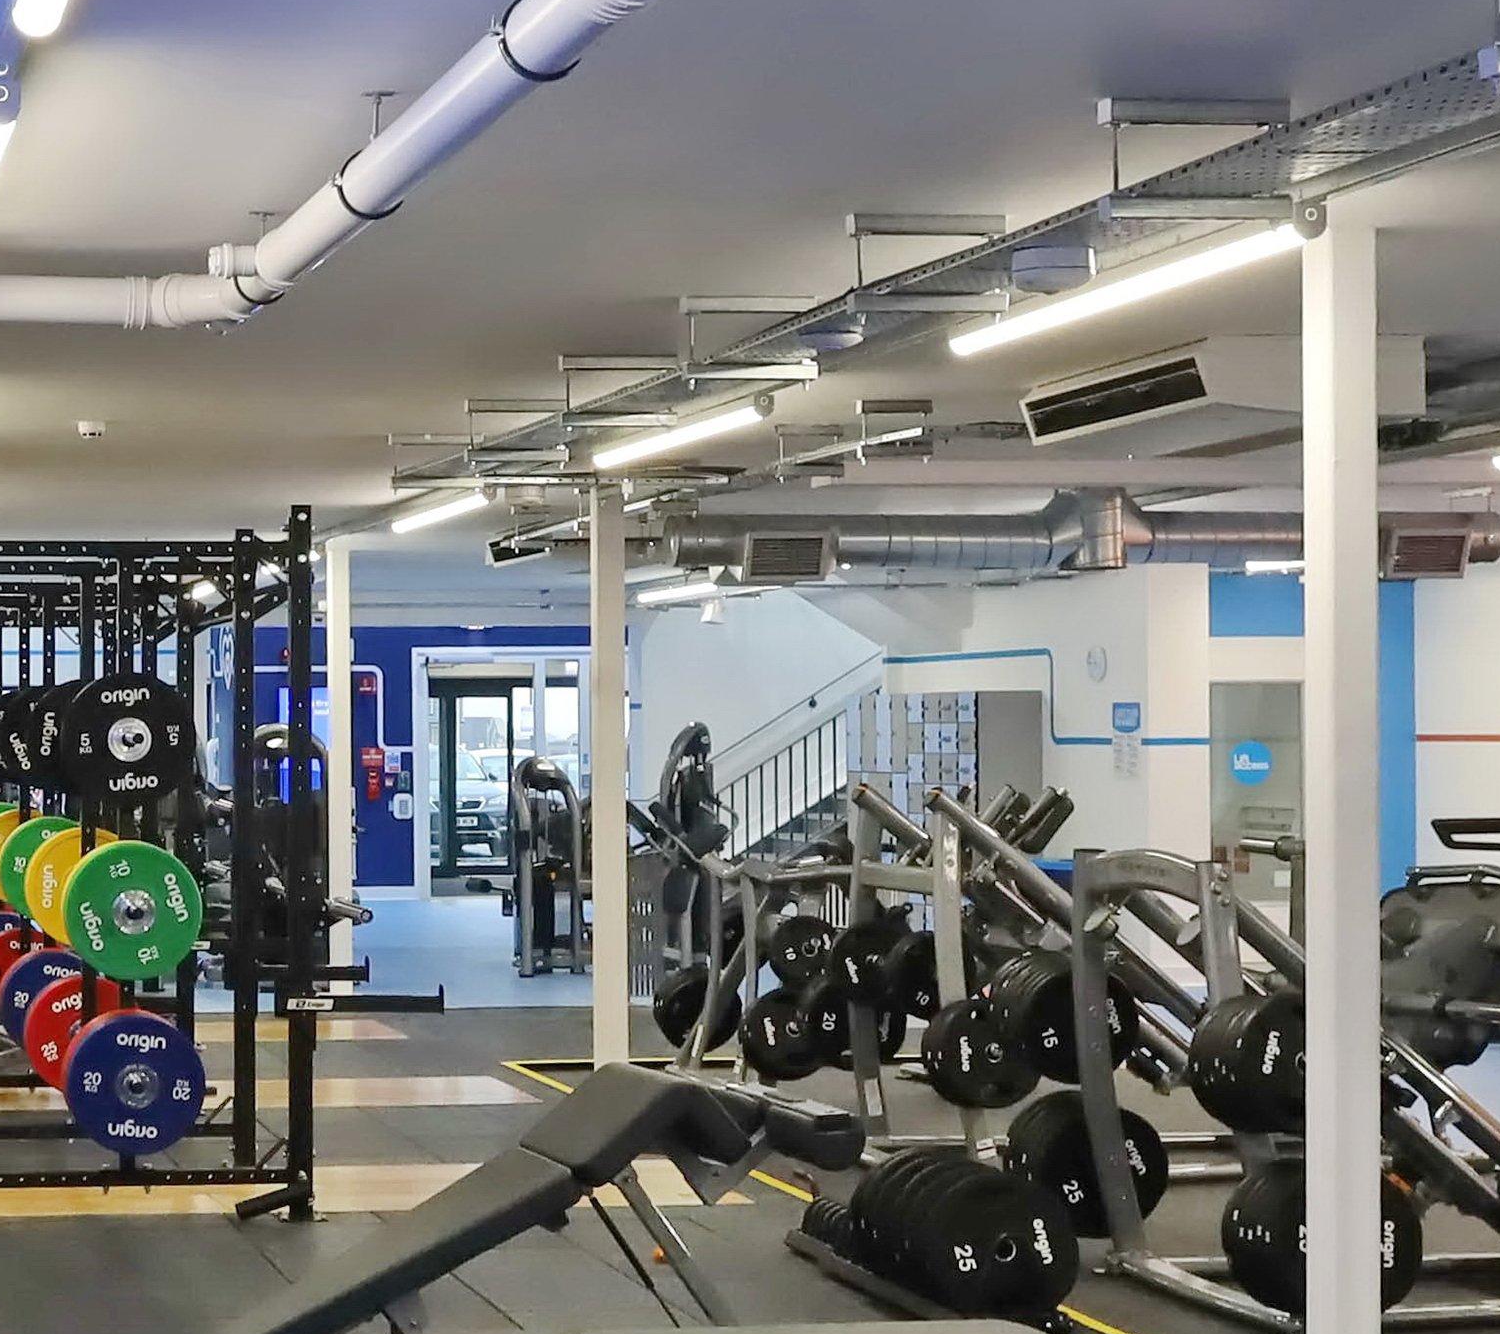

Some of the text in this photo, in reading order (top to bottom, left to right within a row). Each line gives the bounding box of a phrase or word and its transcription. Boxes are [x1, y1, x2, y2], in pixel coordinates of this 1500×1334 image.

[101, 687, 150, 706] origin
[40, 712, 58, 756] origin
[80, 733, 90, 746] 5
[169, 733, 179, 746] 5
[9, 732, 31, 770] origin
[109, 772, 158, 791] origin
[14, 856, 26, 867] 10
[115, 859, 131, 877] 10
[42, 864, 58, 909] origin
[164, 873, 189, 923] origin
[79, 901, 104, 951] origin
[137, 946, 154, 965] 10
[784, 946, 798, 961] 10
[14, 991, 29, 1003] 20
[914, 991, 931, 1007] 10
[822, 1012, 837, 1031] 20
[116, 1033, 167, 1053] origin
[1041, 1027, 1060, 1049] 15
[40, 1041, 58, 1058] 25
[1261, 1030, 1282, 1076] origin
[83, 1072, 102, 1086] 20
[172, 1086, 191, 1100] 20
[108, 1119, 158, 1139] origin
[1124, 1138, 1148, 1176] origin
[1062, 1179, 1085, 1205] 25
[1032, 1217, 1054, 1266] origin
[1380, 1220, 1396, 1268] origin
[953, 1244, 979, 1273] 25
